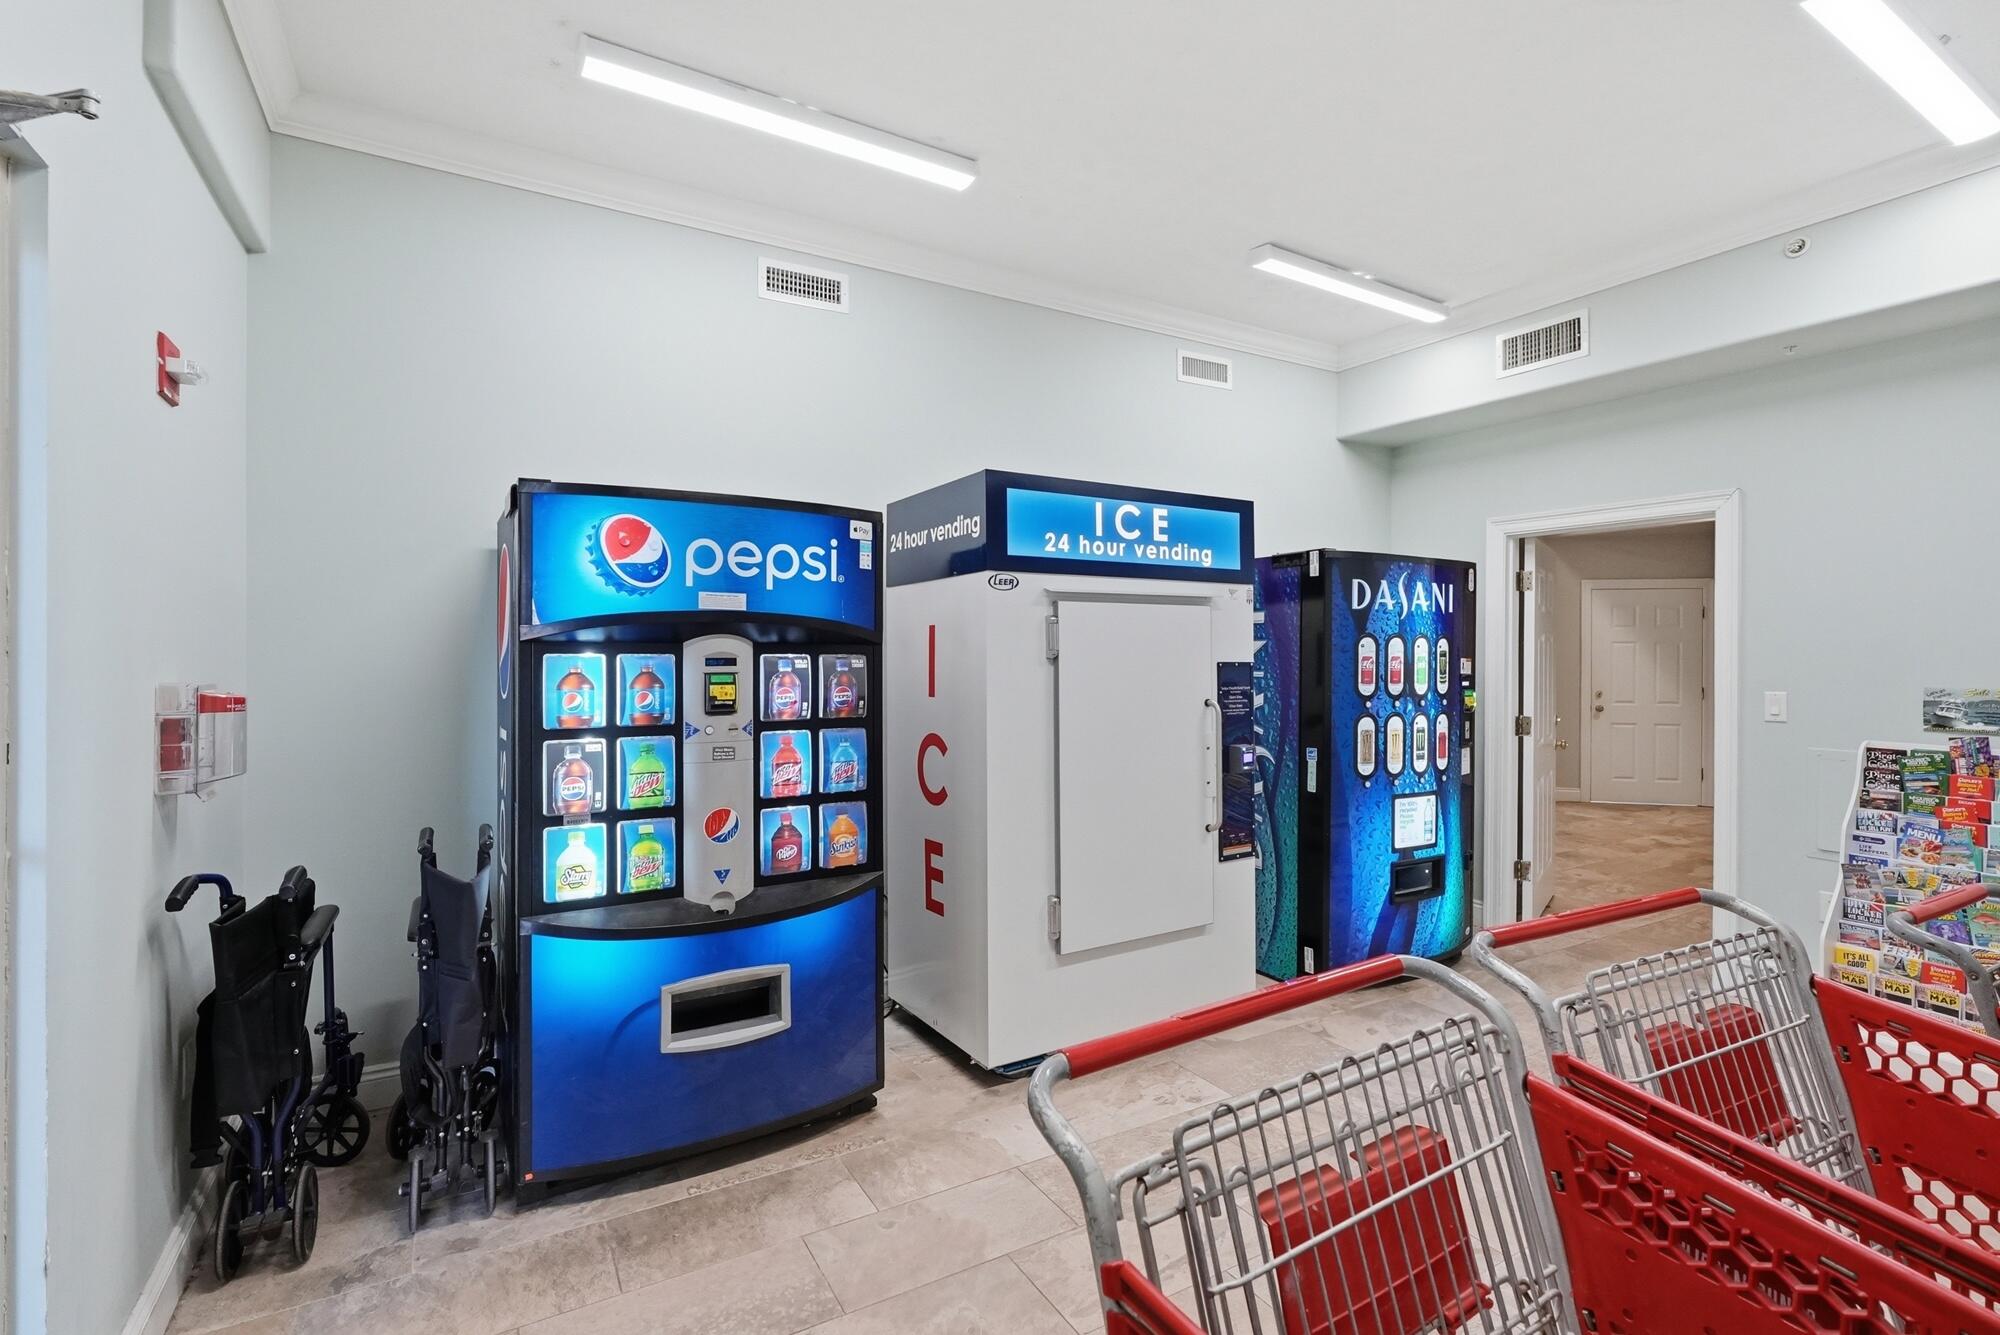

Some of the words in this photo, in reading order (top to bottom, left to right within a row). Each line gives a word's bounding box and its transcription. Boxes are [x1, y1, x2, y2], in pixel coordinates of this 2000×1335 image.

[1095, 502, 1168, 542] ICE
[890, 532, 903, 553] 24
[904, 528, 929, 549] hour
[930, 514, 981, 541] vending
[1044, 532, 1070, 552] 24
[1079, 535, 1125, 557] hour
[1134, 542, 1212, 567] vending
[685, 538, 838, 591] pepsi
[993, 574, 1015, 589] LEER
[1351, 571, 1453, 620] DASANI
[917, 624, 948, 917] ICE
[1906, 828, 1941, 843] MENU
[1847, 907, 1882, 919] LOCKER
[1843, 952, 1856, 960] IT'S
[1859, 954, 1870, 962] ALL
[1847, 960, 1867, 969] GOOD!
[1841, 974, 1865, 985] MAP
[1884, 983, 1910, 995] MAP
[1929, 994, 1957, 1006] MAP
